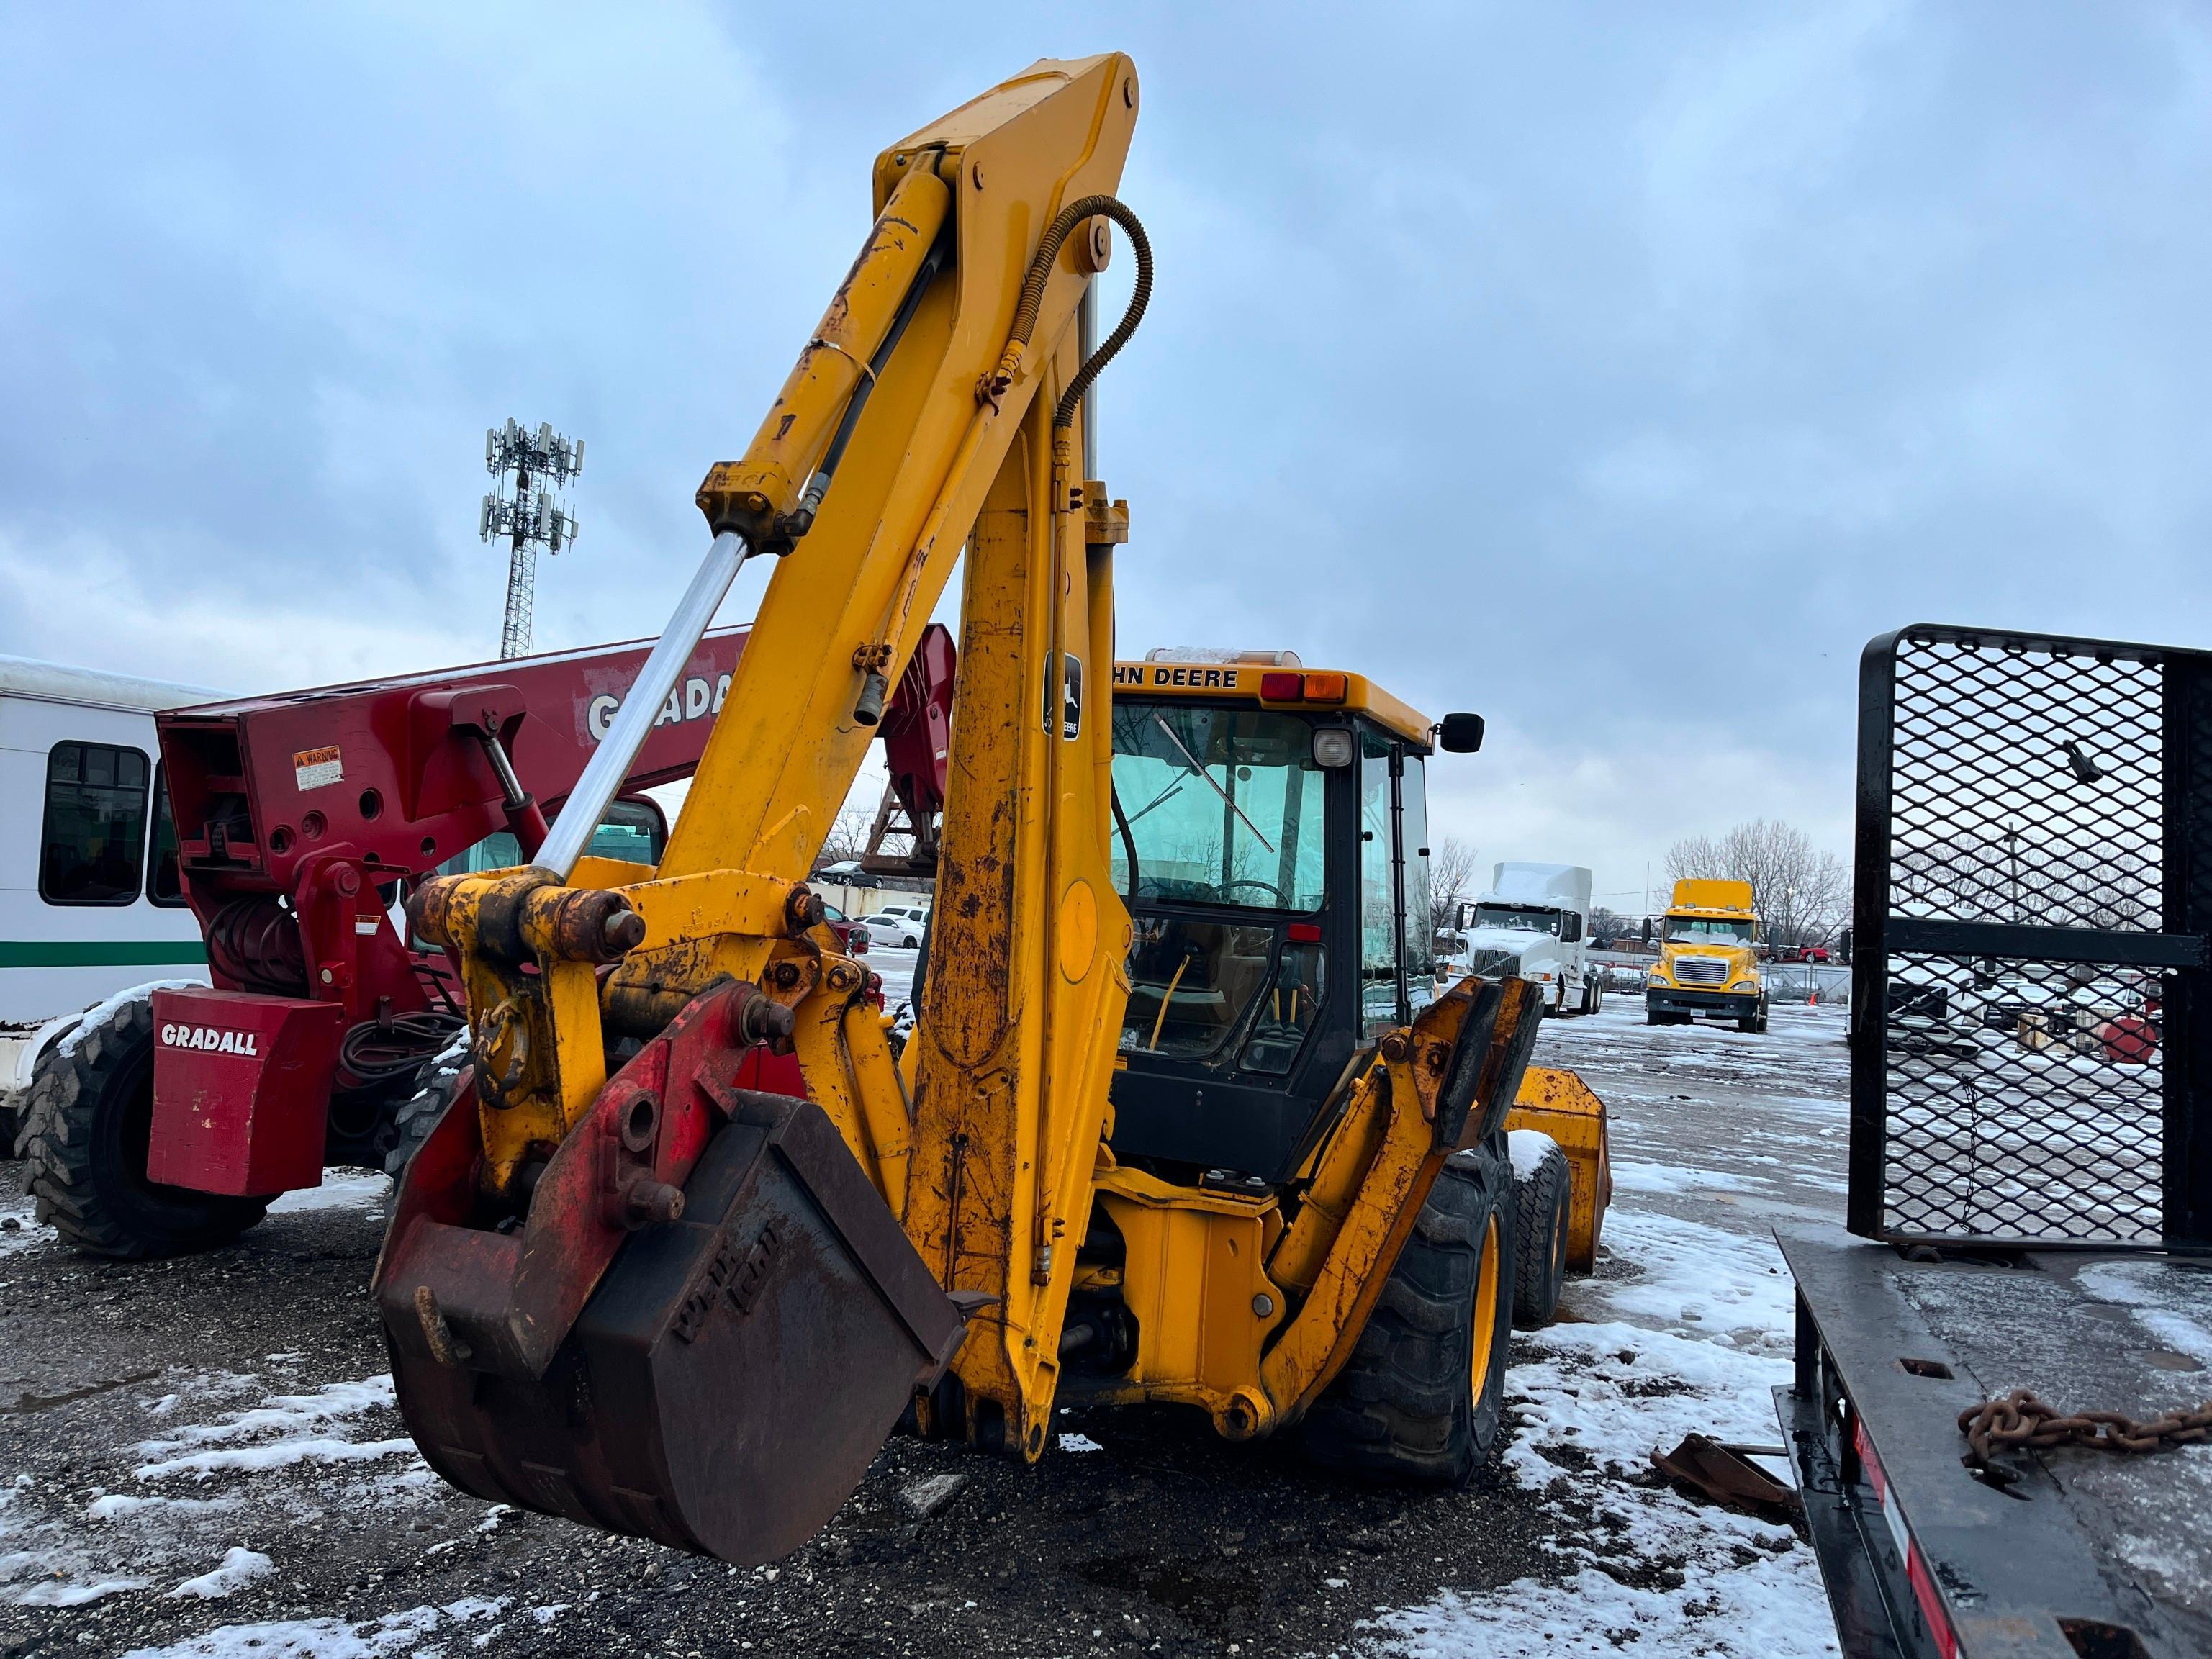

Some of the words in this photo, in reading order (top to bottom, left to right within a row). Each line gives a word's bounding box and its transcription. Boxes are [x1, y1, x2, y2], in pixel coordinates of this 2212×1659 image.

[1113, 667, 1144, 685] HN
[1153, 668, 1239, 690] DEERE
[589, 674, 732, 741] GADA
[1064, 721, 1078, 733] EERE
[306, 749, 338, 764] WARNING
[161, 1023, 258, 1056] GRADALL
